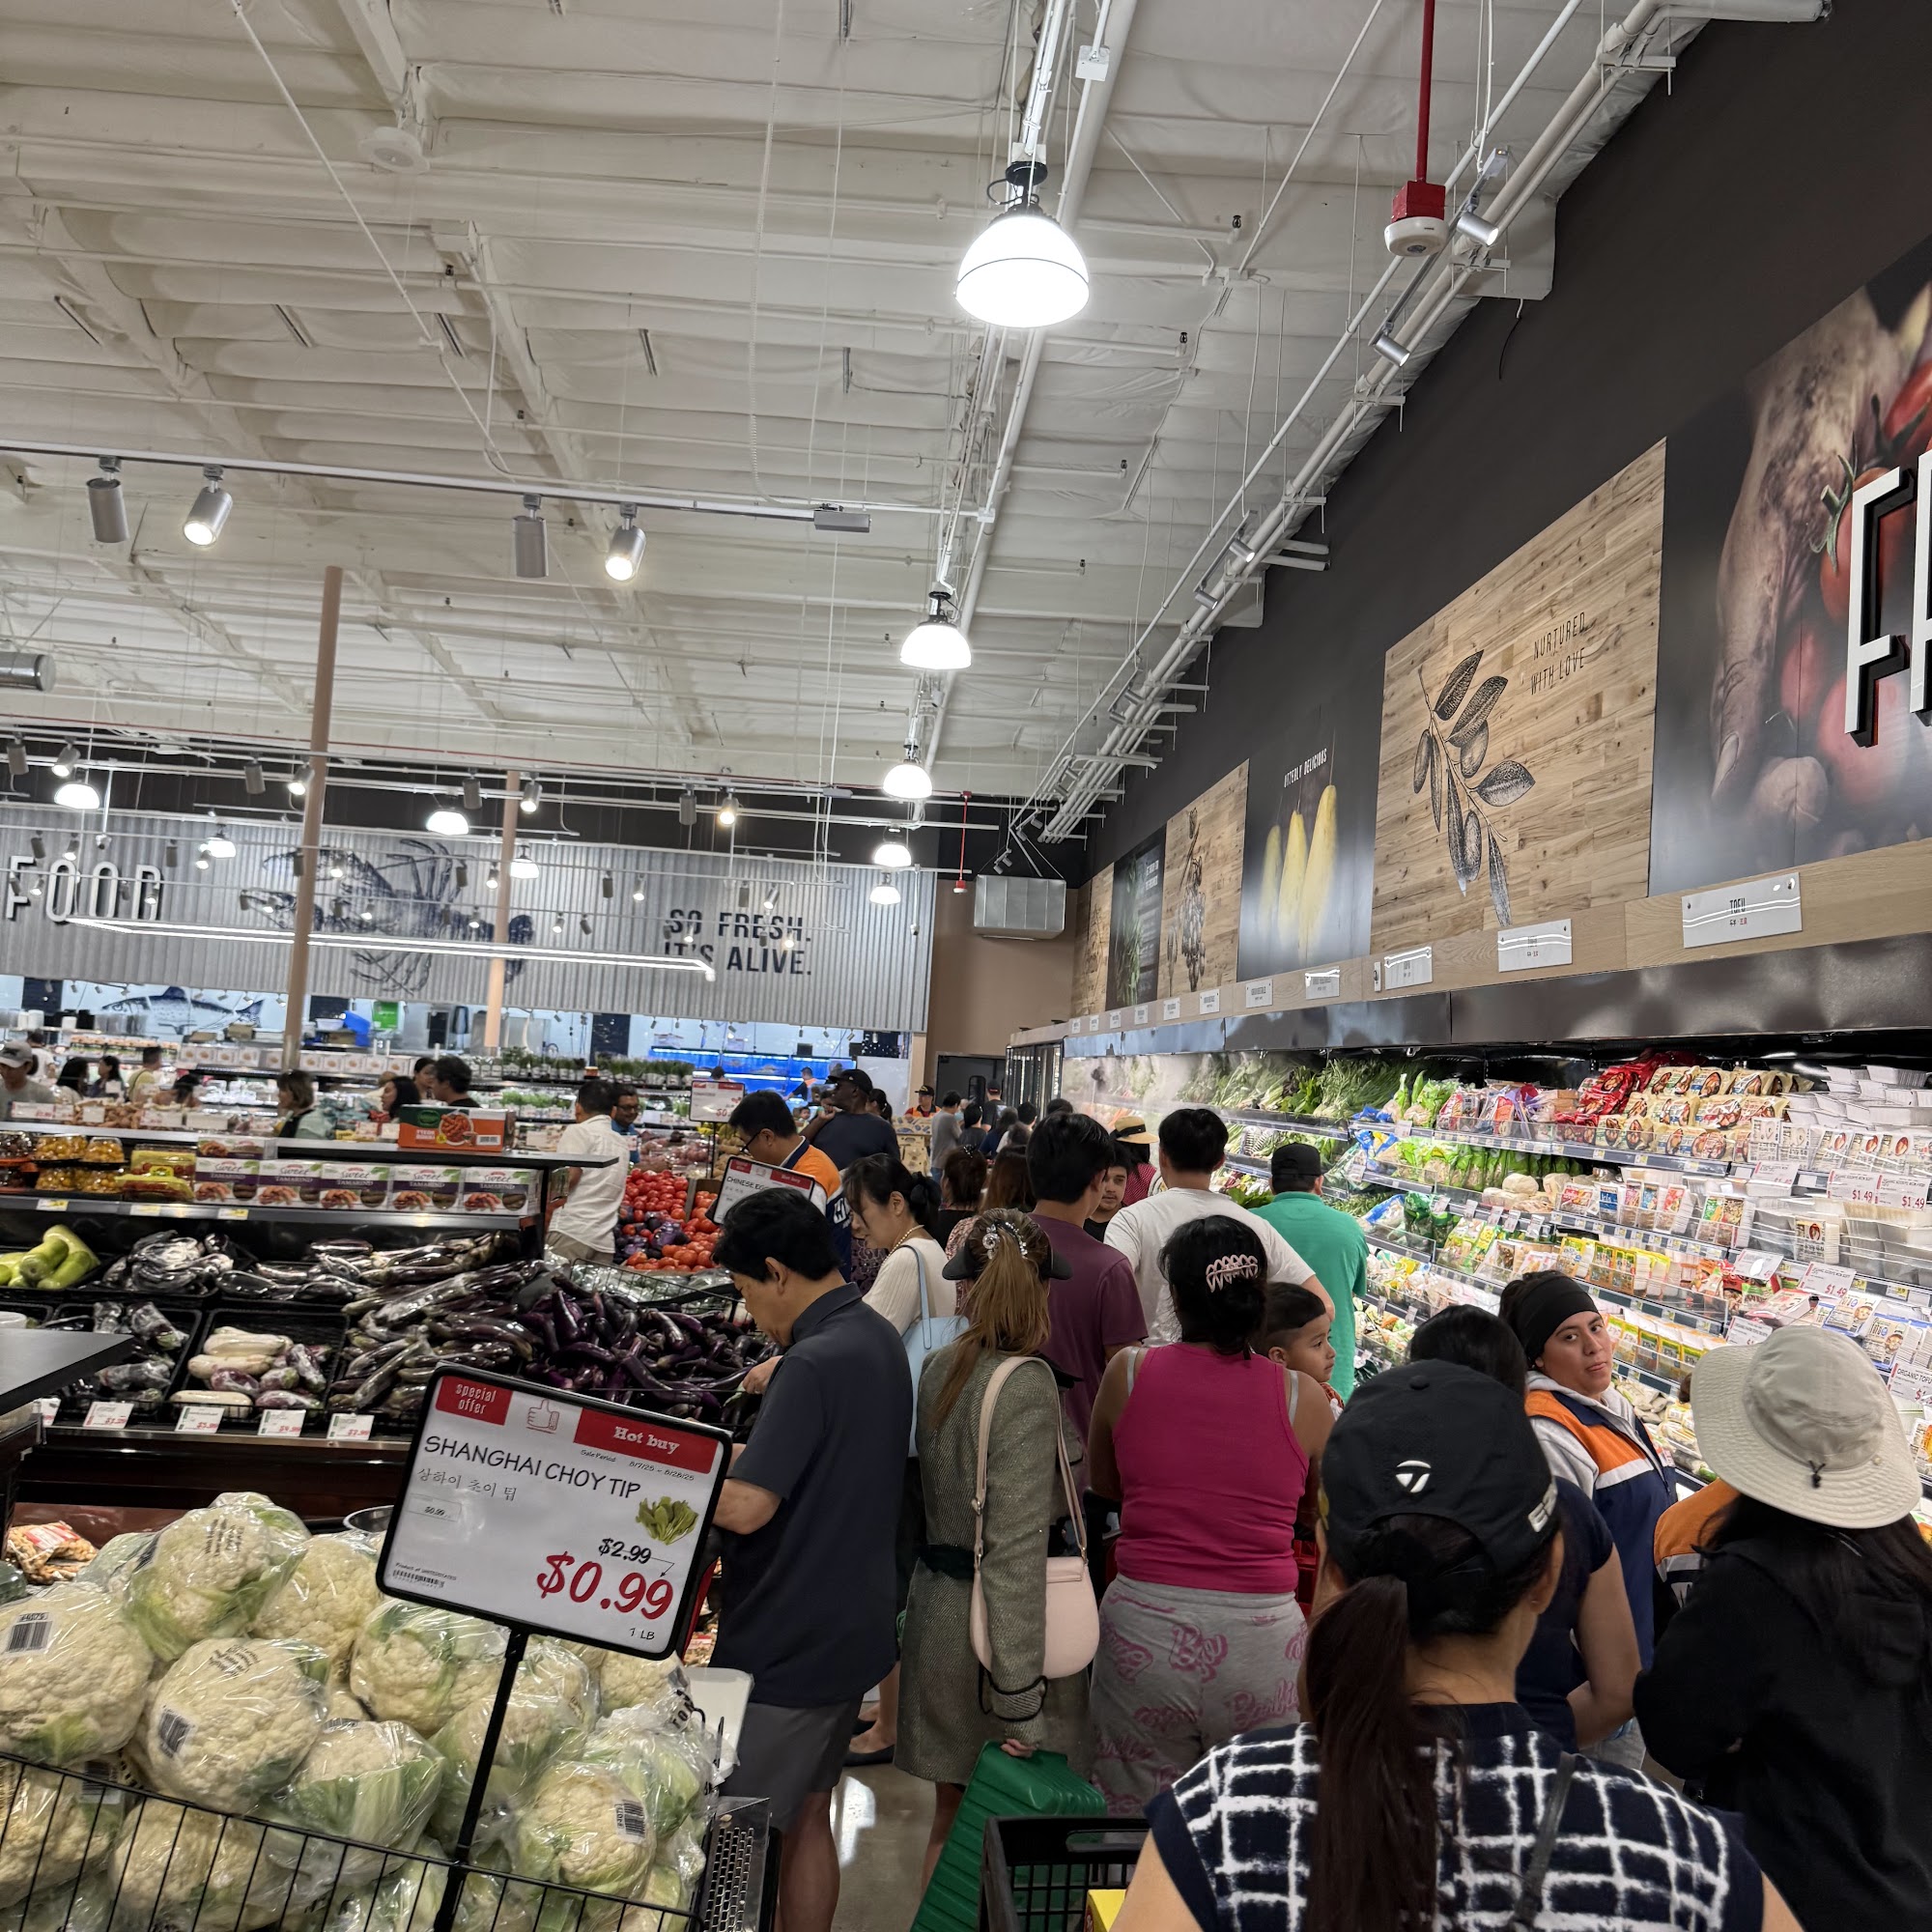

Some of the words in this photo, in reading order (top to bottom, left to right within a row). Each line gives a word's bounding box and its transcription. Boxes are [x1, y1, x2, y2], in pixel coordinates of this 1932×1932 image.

[1533, 611, 1585, 661] NURTURED
[1530, 665, 1554, 696] WITH
[1559, 647, 1585, 680] LOVE
[1729, 897, 1747, 914] TOFU
[669, 908, 703, 935] SO
[718, 912, 811, 942] FRESH.
[725, 946, 811, 976] ALIVE.
[726, 1176, 753, 1189] CHINESE
[1852, 1189, 1873, 1203] $1.49
[1901, 1196, 1925, 1209] $1.49
[1896, 1368, 1919, 1380] ORGANIC
[455, 1383, 497, 1404] special
[458, 1398, 487, 1414] offer
[612, 1426, 644, 1444] Hot
[646, 1434, 681, 1455] buy
[424, 1435, 542, 1476] SHANGHAI
[545, 1463, 607, 1491] CHOY
[610, 1478, 641, 1498] TIP
[417, 1467, 462, 1489] 상하이
[468, 1479, 497, 1497] 초이
[598, 1537, 652, 1565] $2.99
[536, 1550, 674, 1620] $0.99
[629, 1628, 636, 1637] 1
[640, 1630, 655, 1640] LB
